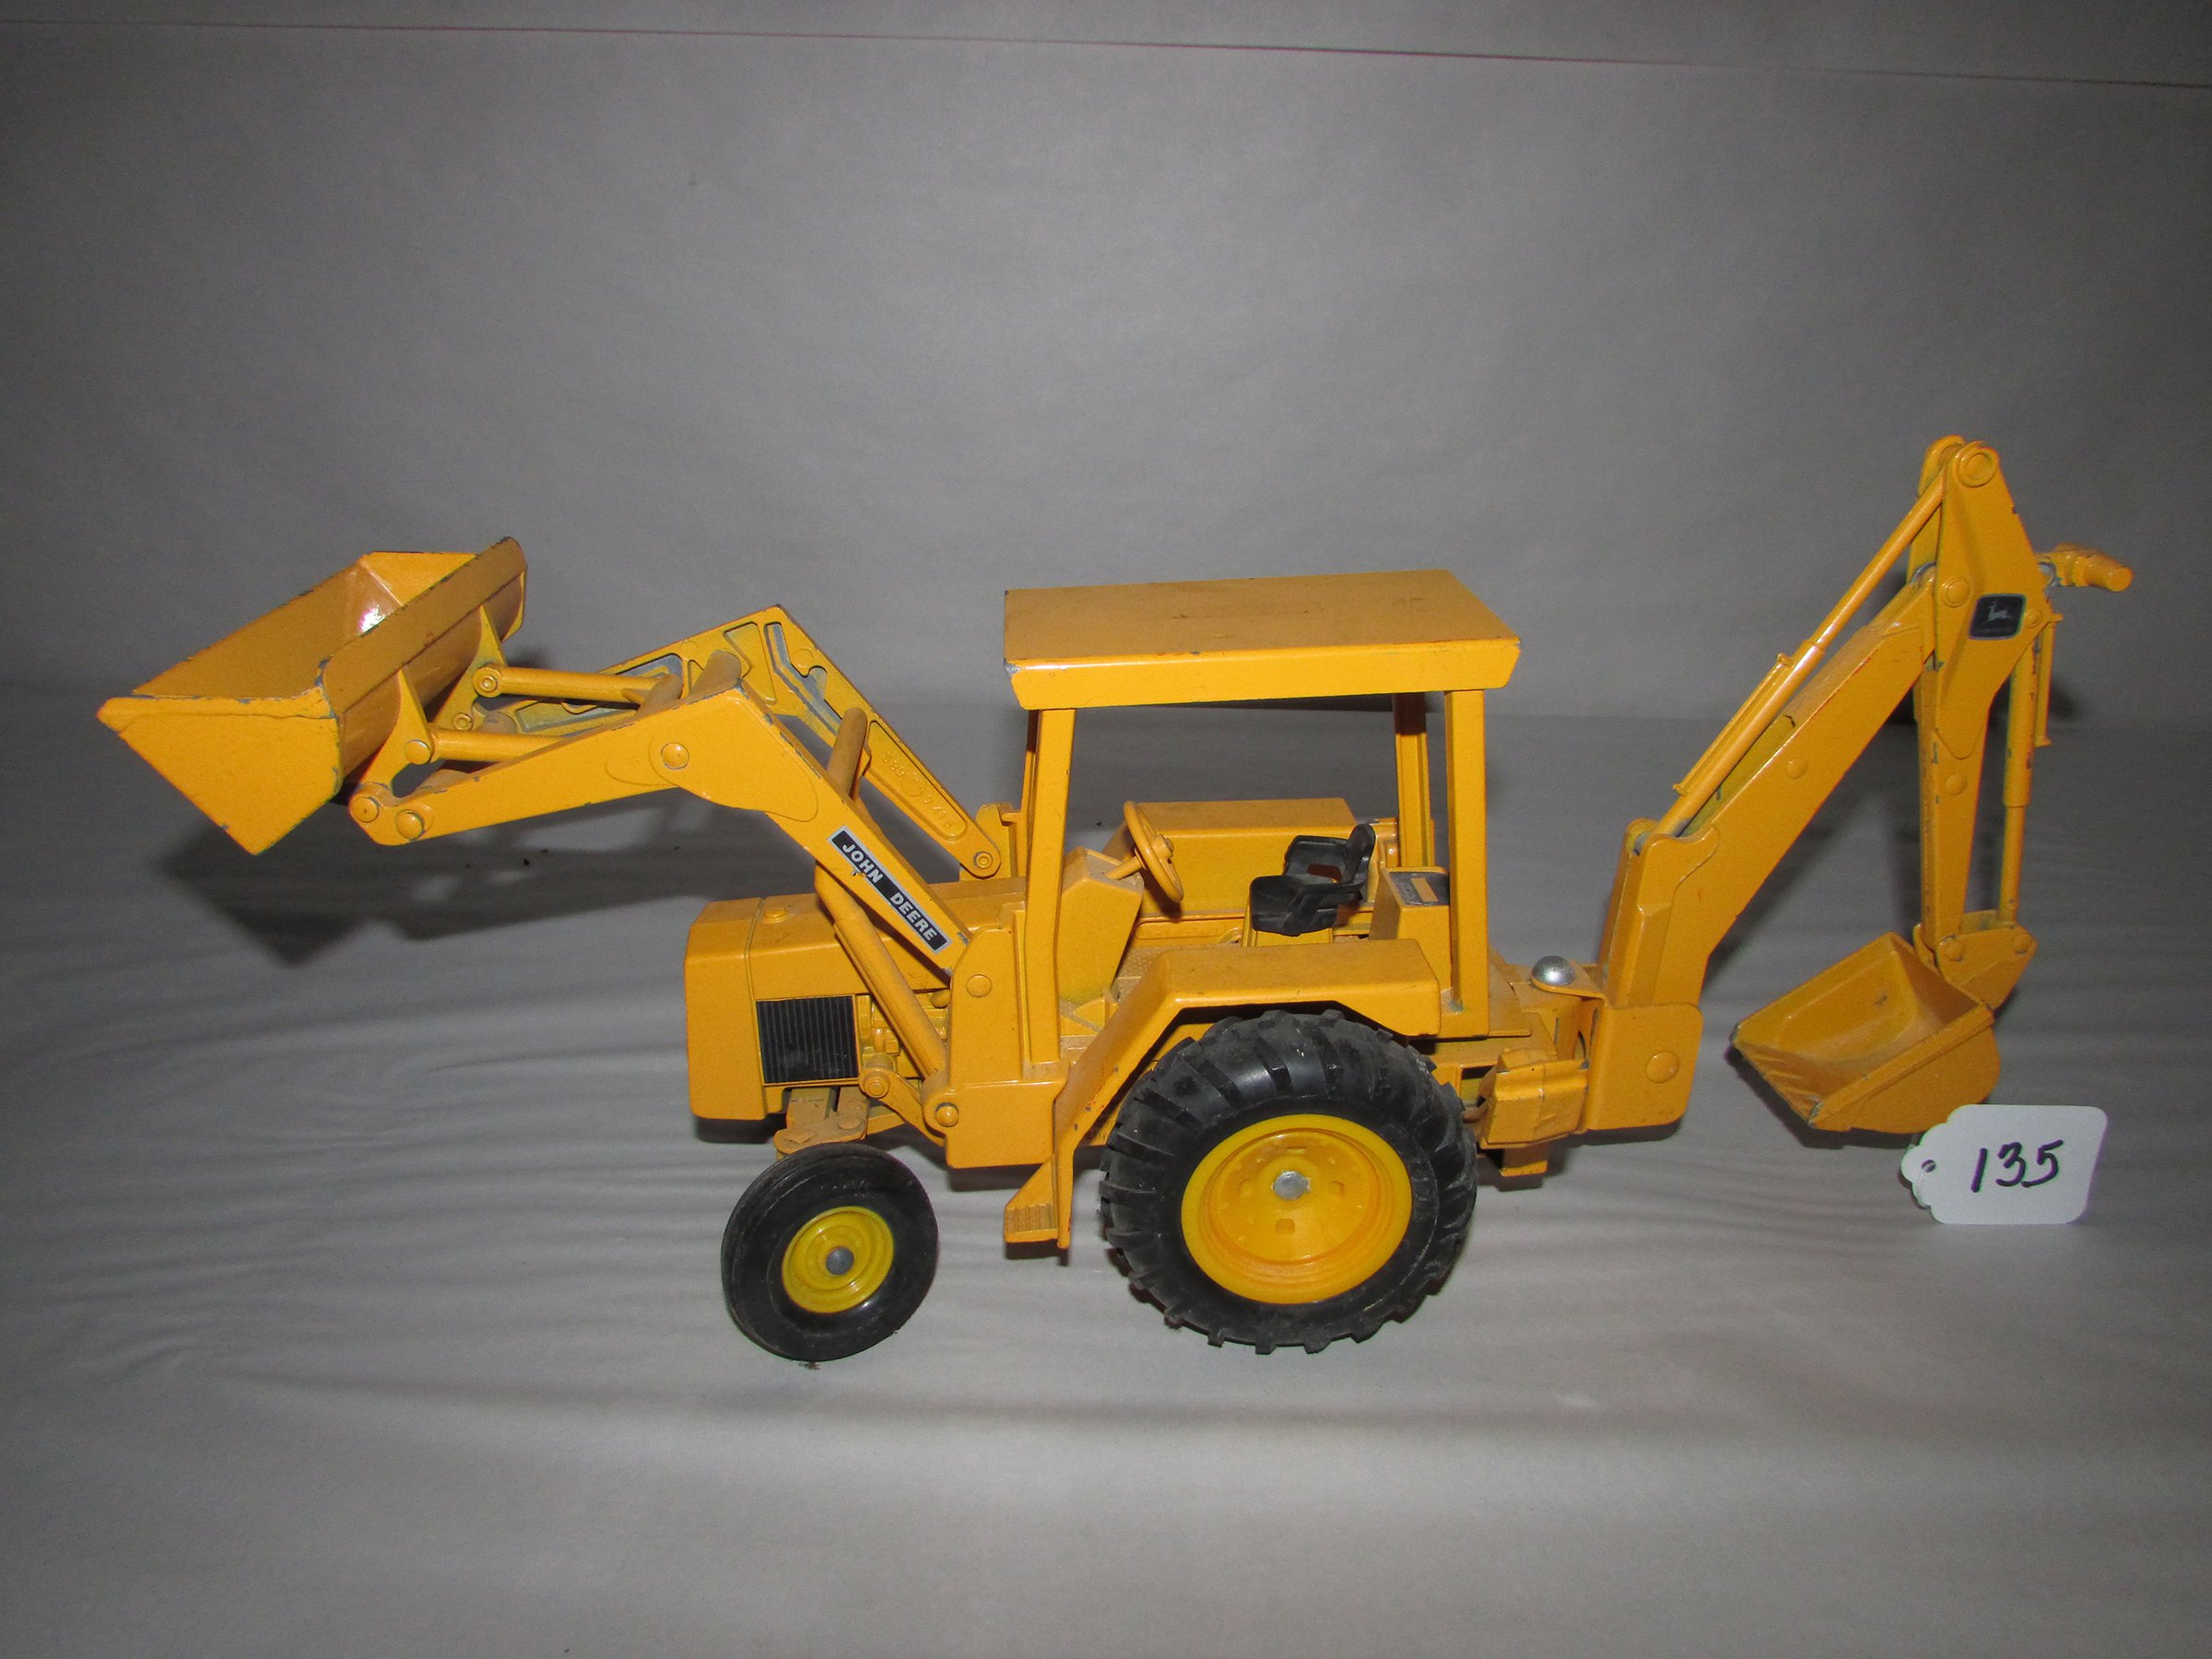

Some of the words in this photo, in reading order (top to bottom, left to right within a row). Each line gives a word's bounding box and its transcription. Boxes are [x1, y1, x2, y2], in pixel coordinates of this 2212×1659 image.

[842, 843, 884, 884] JOHN
[889, 891, 938, 941] DEERE
[1971, 1138, 2065, 1194] 135
